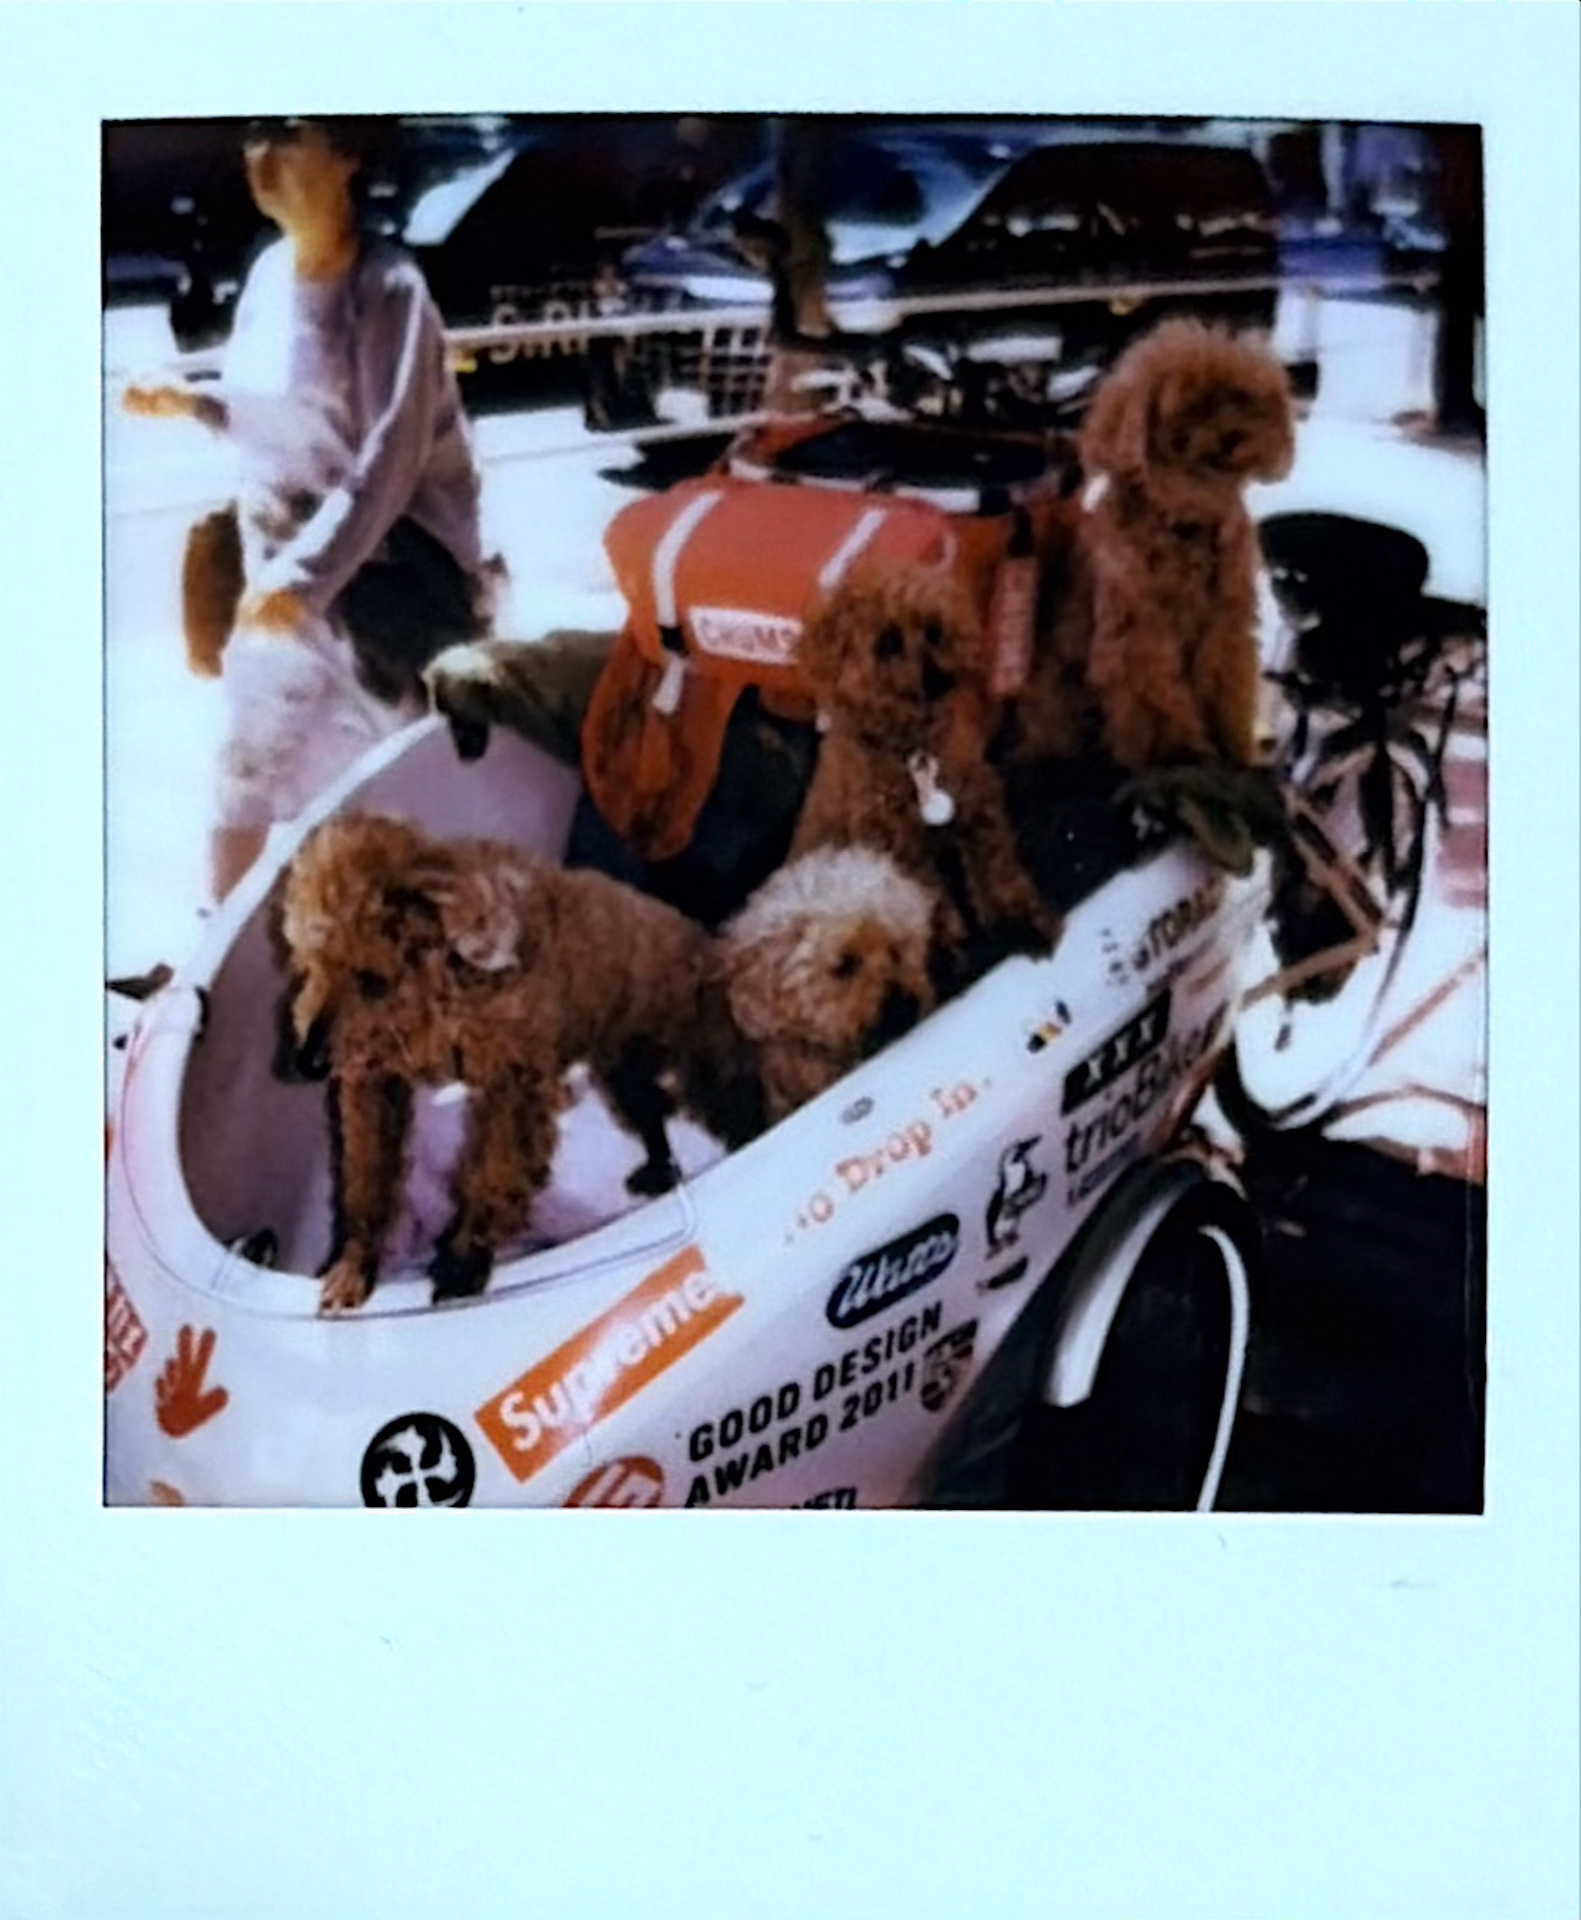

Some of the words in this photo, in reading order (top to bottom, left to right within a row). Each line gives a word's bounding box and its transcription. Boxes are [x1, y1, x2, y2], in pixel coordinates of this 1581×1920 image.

[499, 1270, 719, 1451] Supreme
[685, 1414, 829, 1508] AWARD
[840, 1361, 915, 1433] 2011
[689, 1382, 801, 1462] GOOD
[813, 1301, 942, 1401] DESIGN
